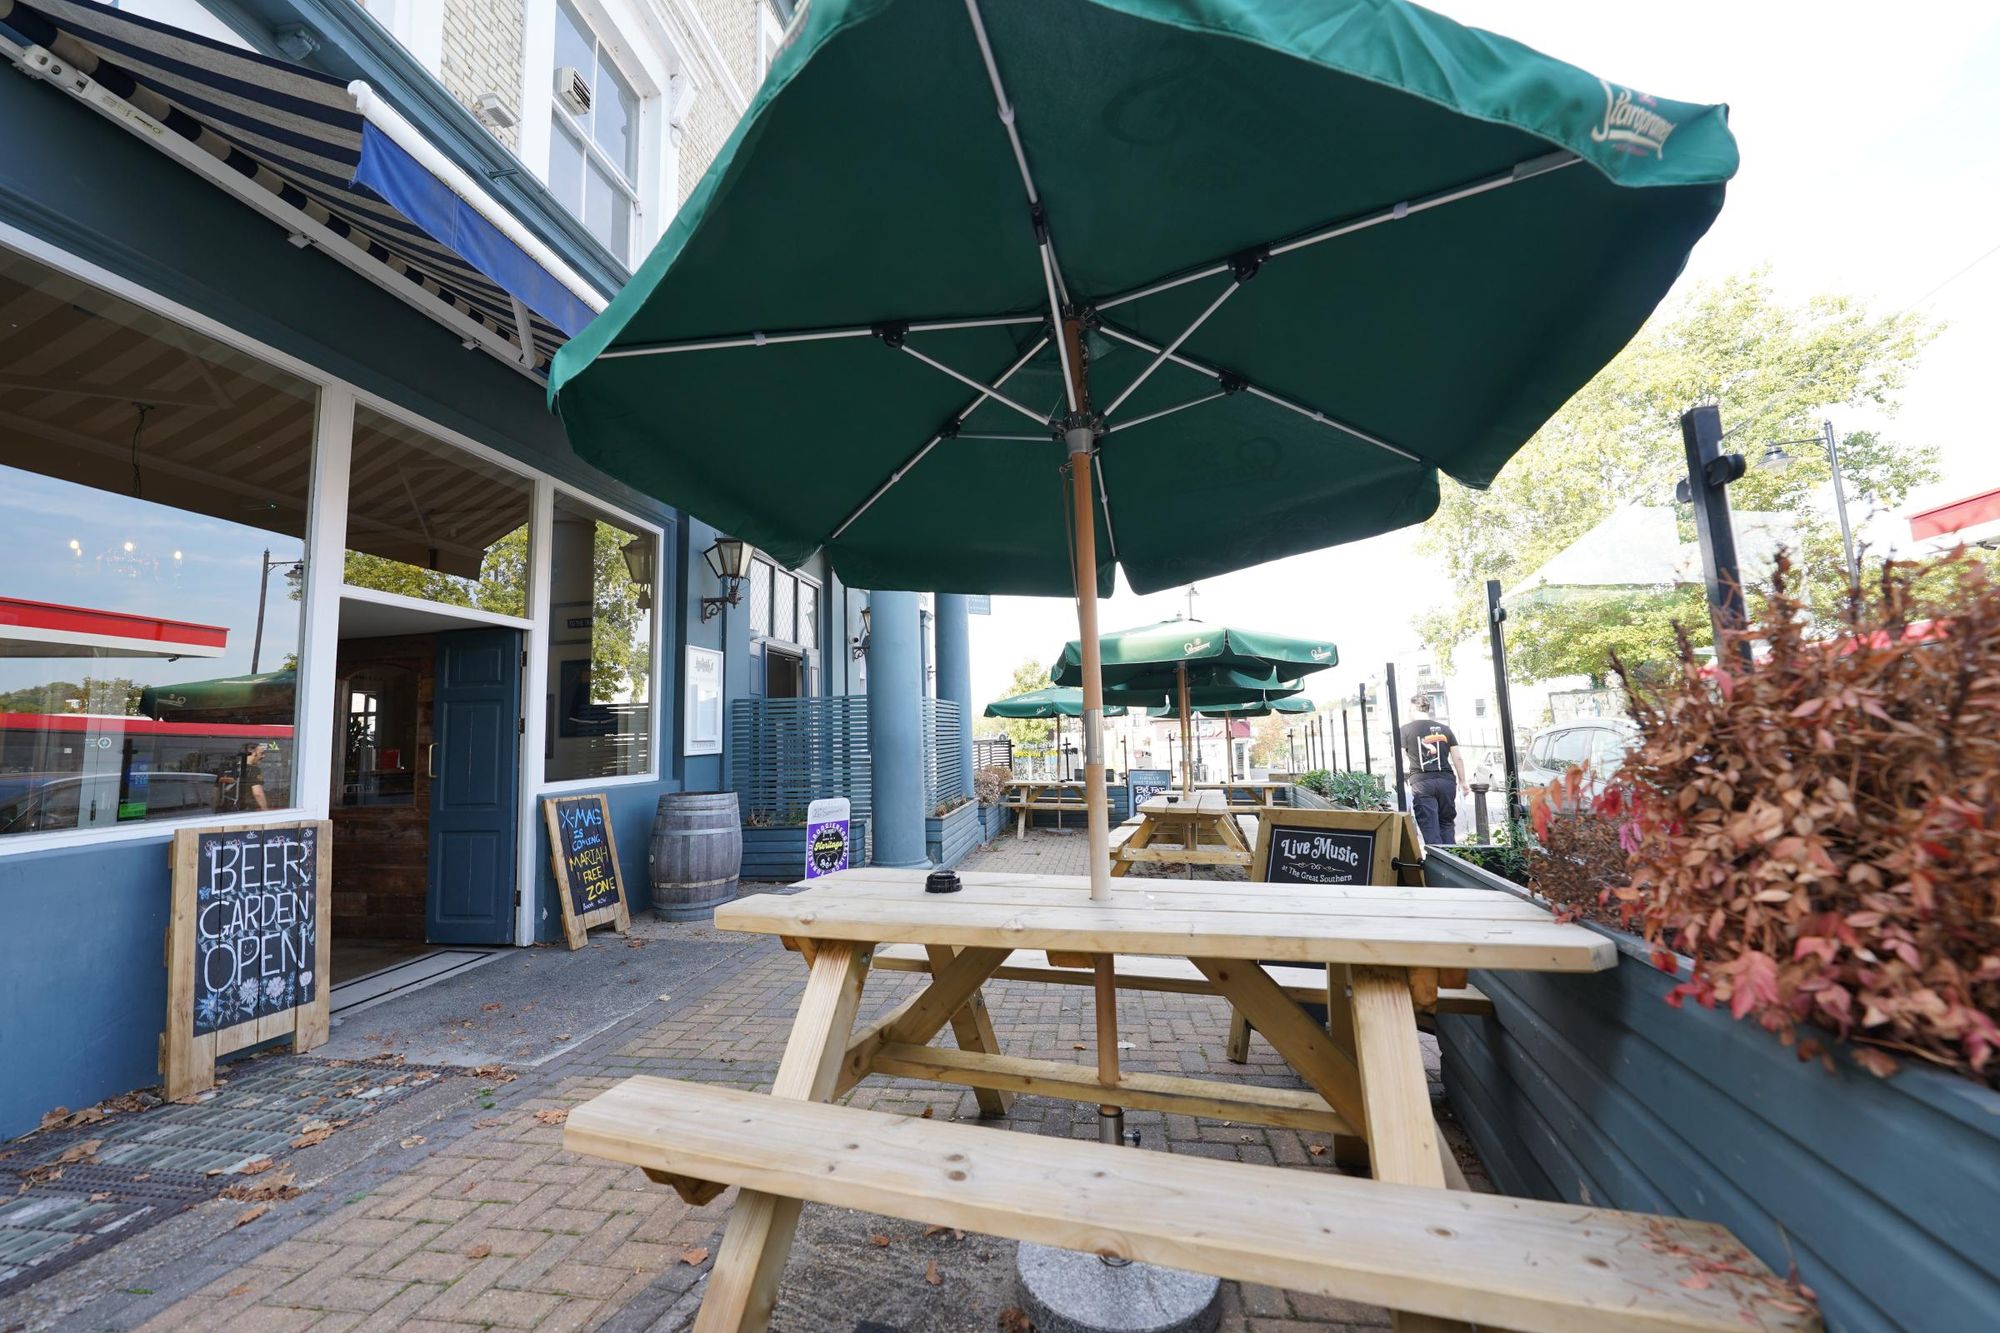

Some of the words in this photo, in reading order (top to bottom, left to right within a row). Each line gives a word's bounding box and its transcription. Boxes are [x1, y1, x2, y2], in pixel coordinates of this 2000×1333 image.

[1591, 79, 1678, 160] Staropr
[560, 808, 602, 829] X-MAS
[573, 828, 584, 839] IS
[814, 840, 843, 852] Heritage
[569, 846, 609, 872] MARIAH
[1281, 838, 1310, 860] Live
[1311, 837, 1359, 866] Music
[211, 842, 310, 895] BEER
[583, 866, 603, 884] FREE
[1281, 865, 1288, 873] at
[1288, 866, 1300, 878] The
[1300, 872, 1319, 883] Great
[1319, 874, 1352, 883] Southern
[586, 876, 616, 901] ZONE
[199, 891, 309, 939] GARDEN
[204, 929, 306, 994] OPEN
